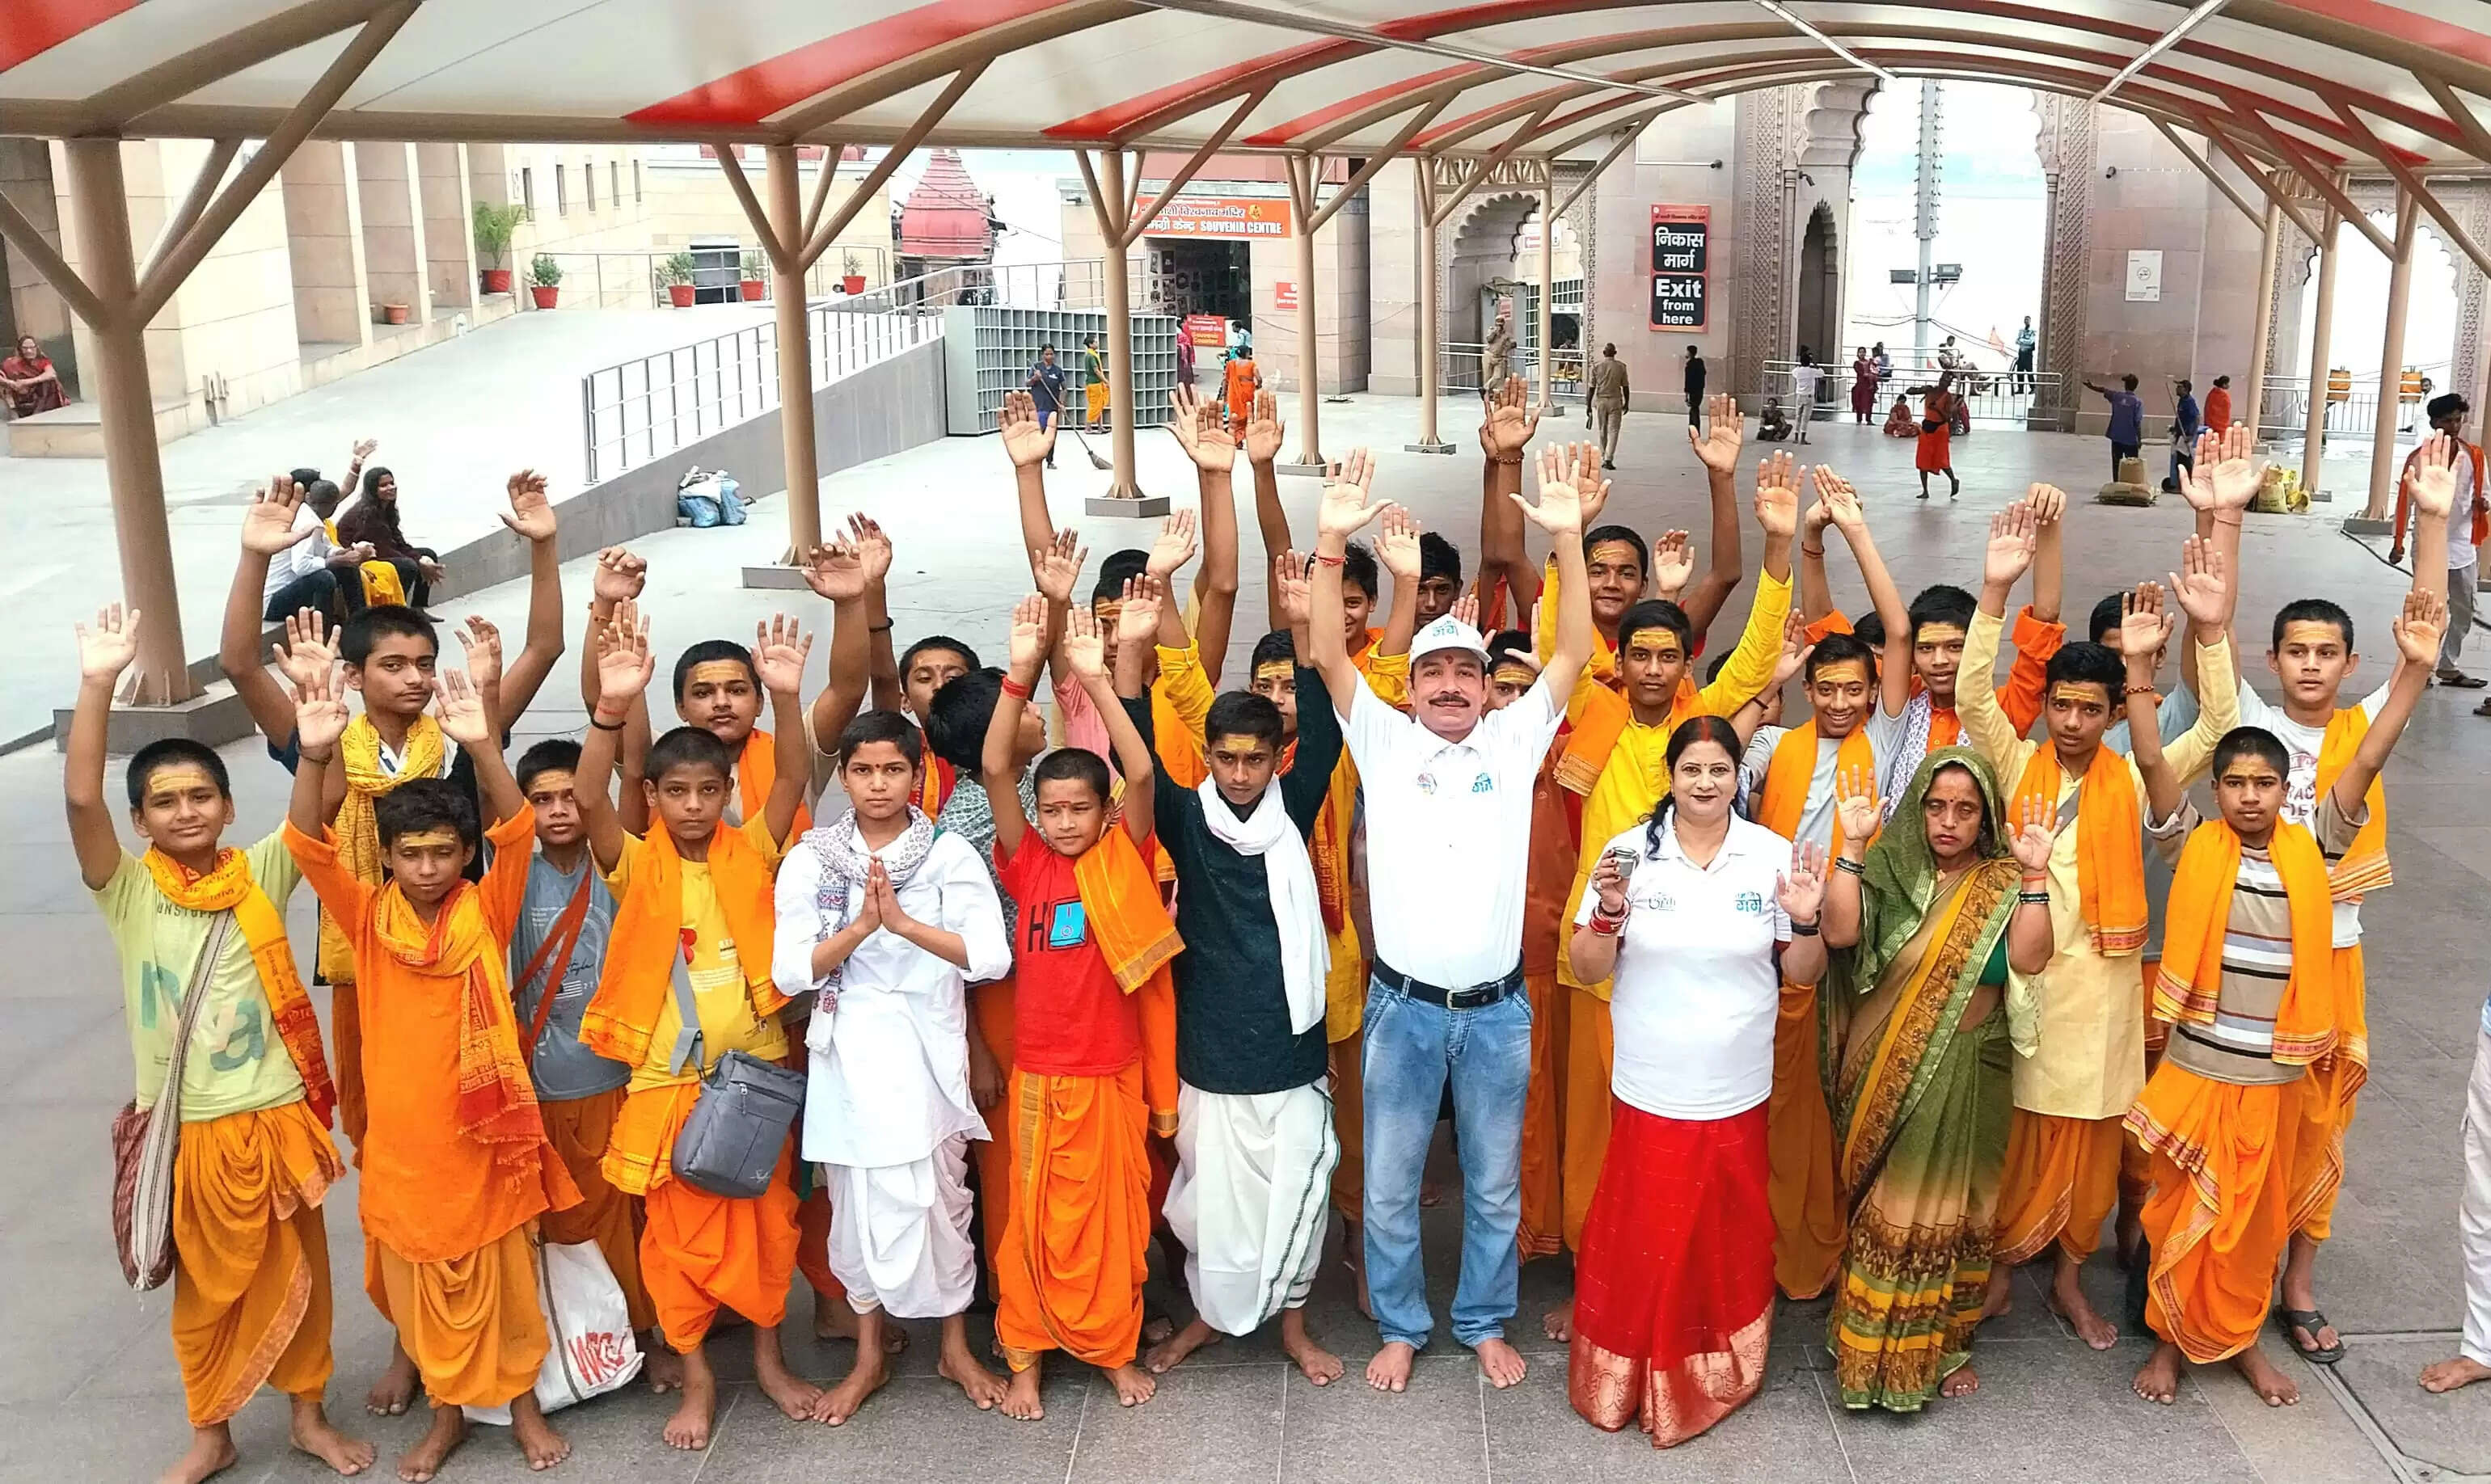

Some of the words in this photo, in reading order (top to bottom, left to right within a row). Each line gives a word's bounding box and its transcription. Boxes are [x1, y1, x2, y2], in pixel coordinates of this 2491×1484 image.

[1200, 221, 1246, 234] SOUVENIR
[1247, 223, 1283, 234] CENTRE
[1654, 226, 1705, 248] निकास
[1662, 249, 1695, 268] मार्ग
[1656, 278, 1702, 297] Exit
[1662, 299, 1695, 311] from
[1662, 313, 1694, 325] here
